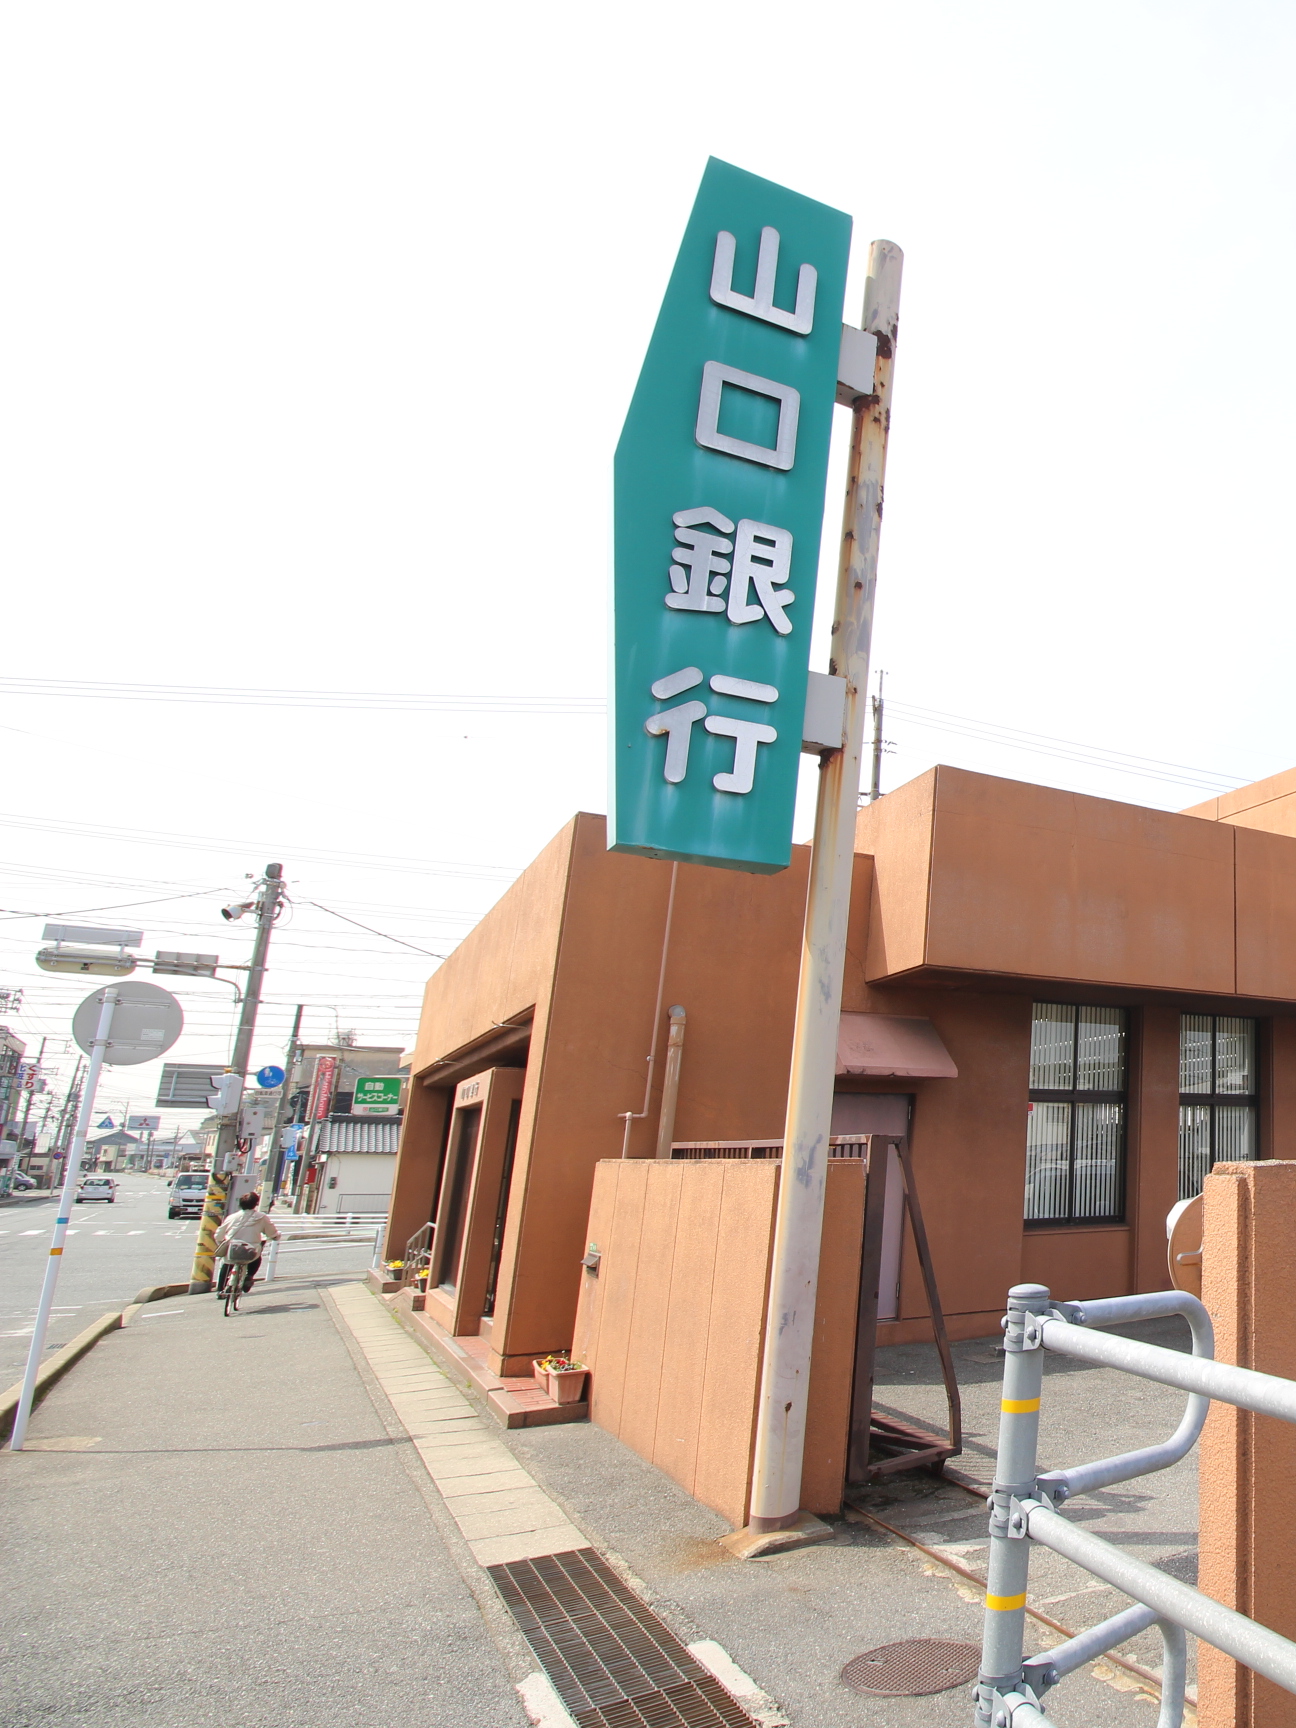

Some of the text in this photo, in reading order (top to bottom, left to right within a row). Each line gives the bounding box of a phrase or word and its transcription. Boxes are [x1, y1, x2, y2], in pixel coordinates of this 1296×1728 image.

[645, 225, 818, 795] 山口銀行
[25, 1065, 37, 1089] くすり
[364, 1082, 384, 1091] 自動
[357, 1092, 398, 1102] サービスコーナー
